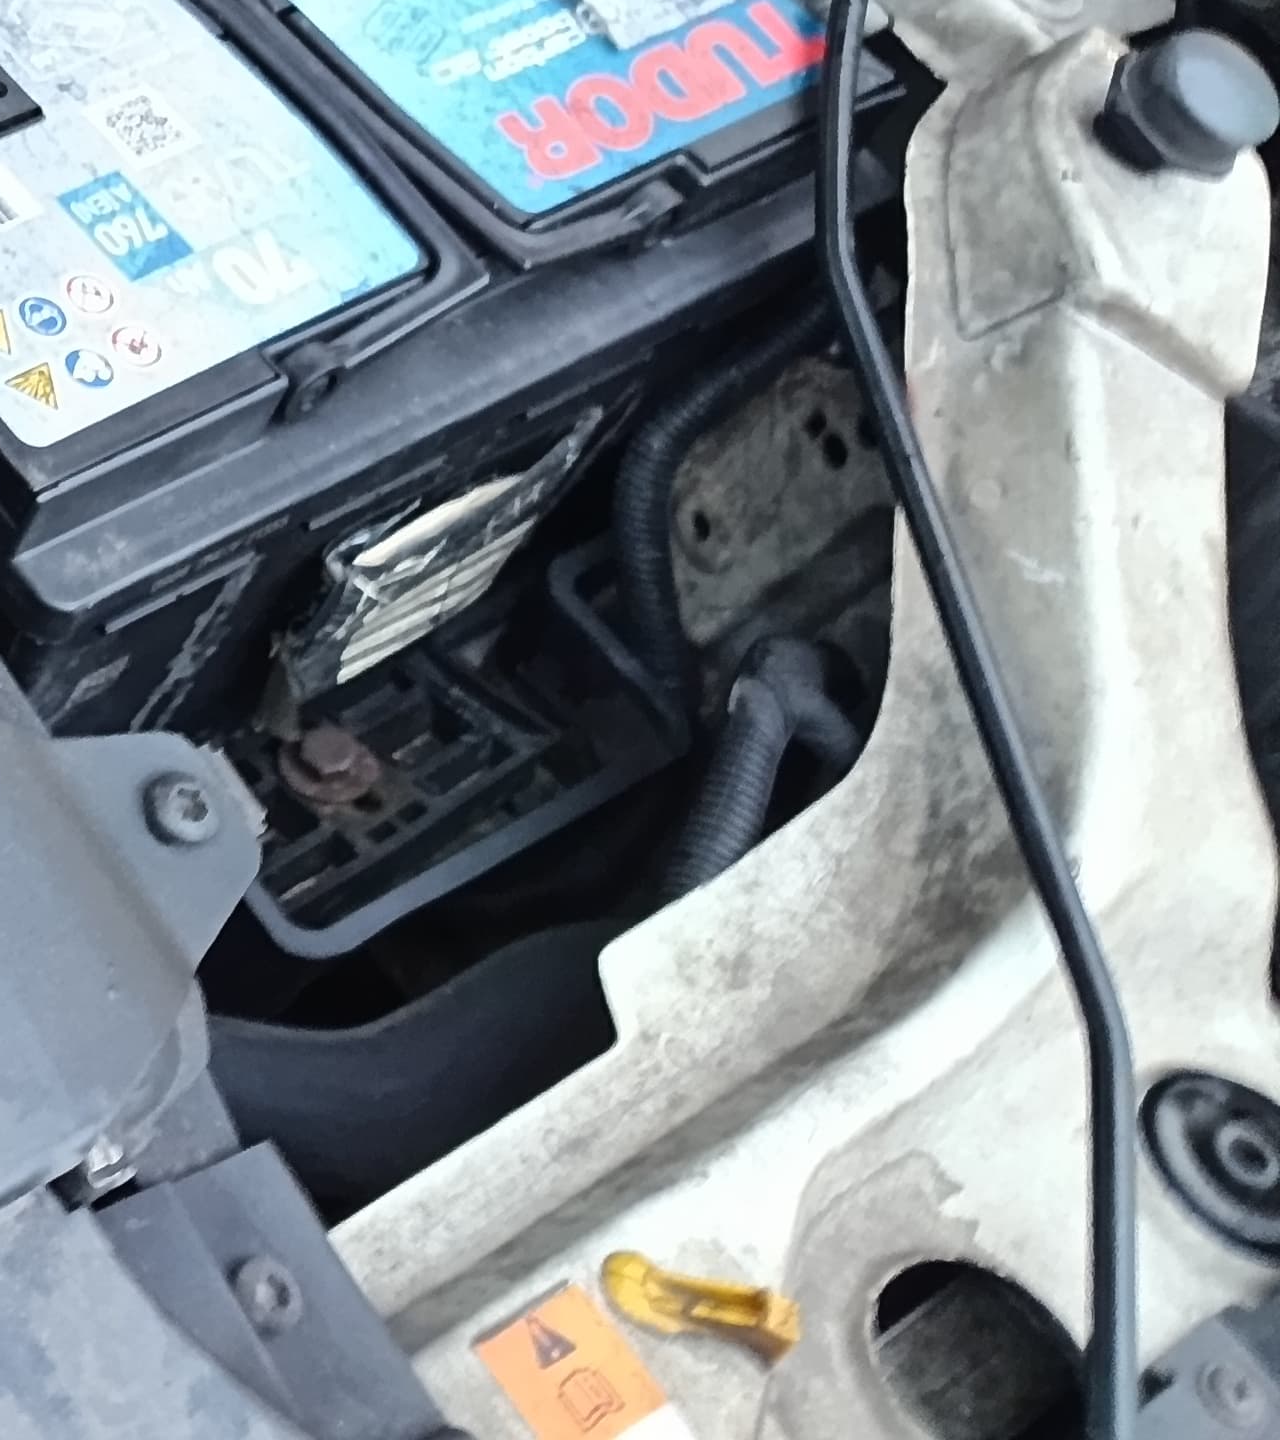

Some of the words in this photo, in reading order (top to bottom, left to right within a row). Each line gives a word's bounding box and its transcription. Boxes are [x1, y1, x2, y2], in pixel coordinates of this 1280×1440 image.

[497, 0, 827, 180] TUDOR
[93, 205, 169, 257] 760
[212, 226, 320, 305] 70
